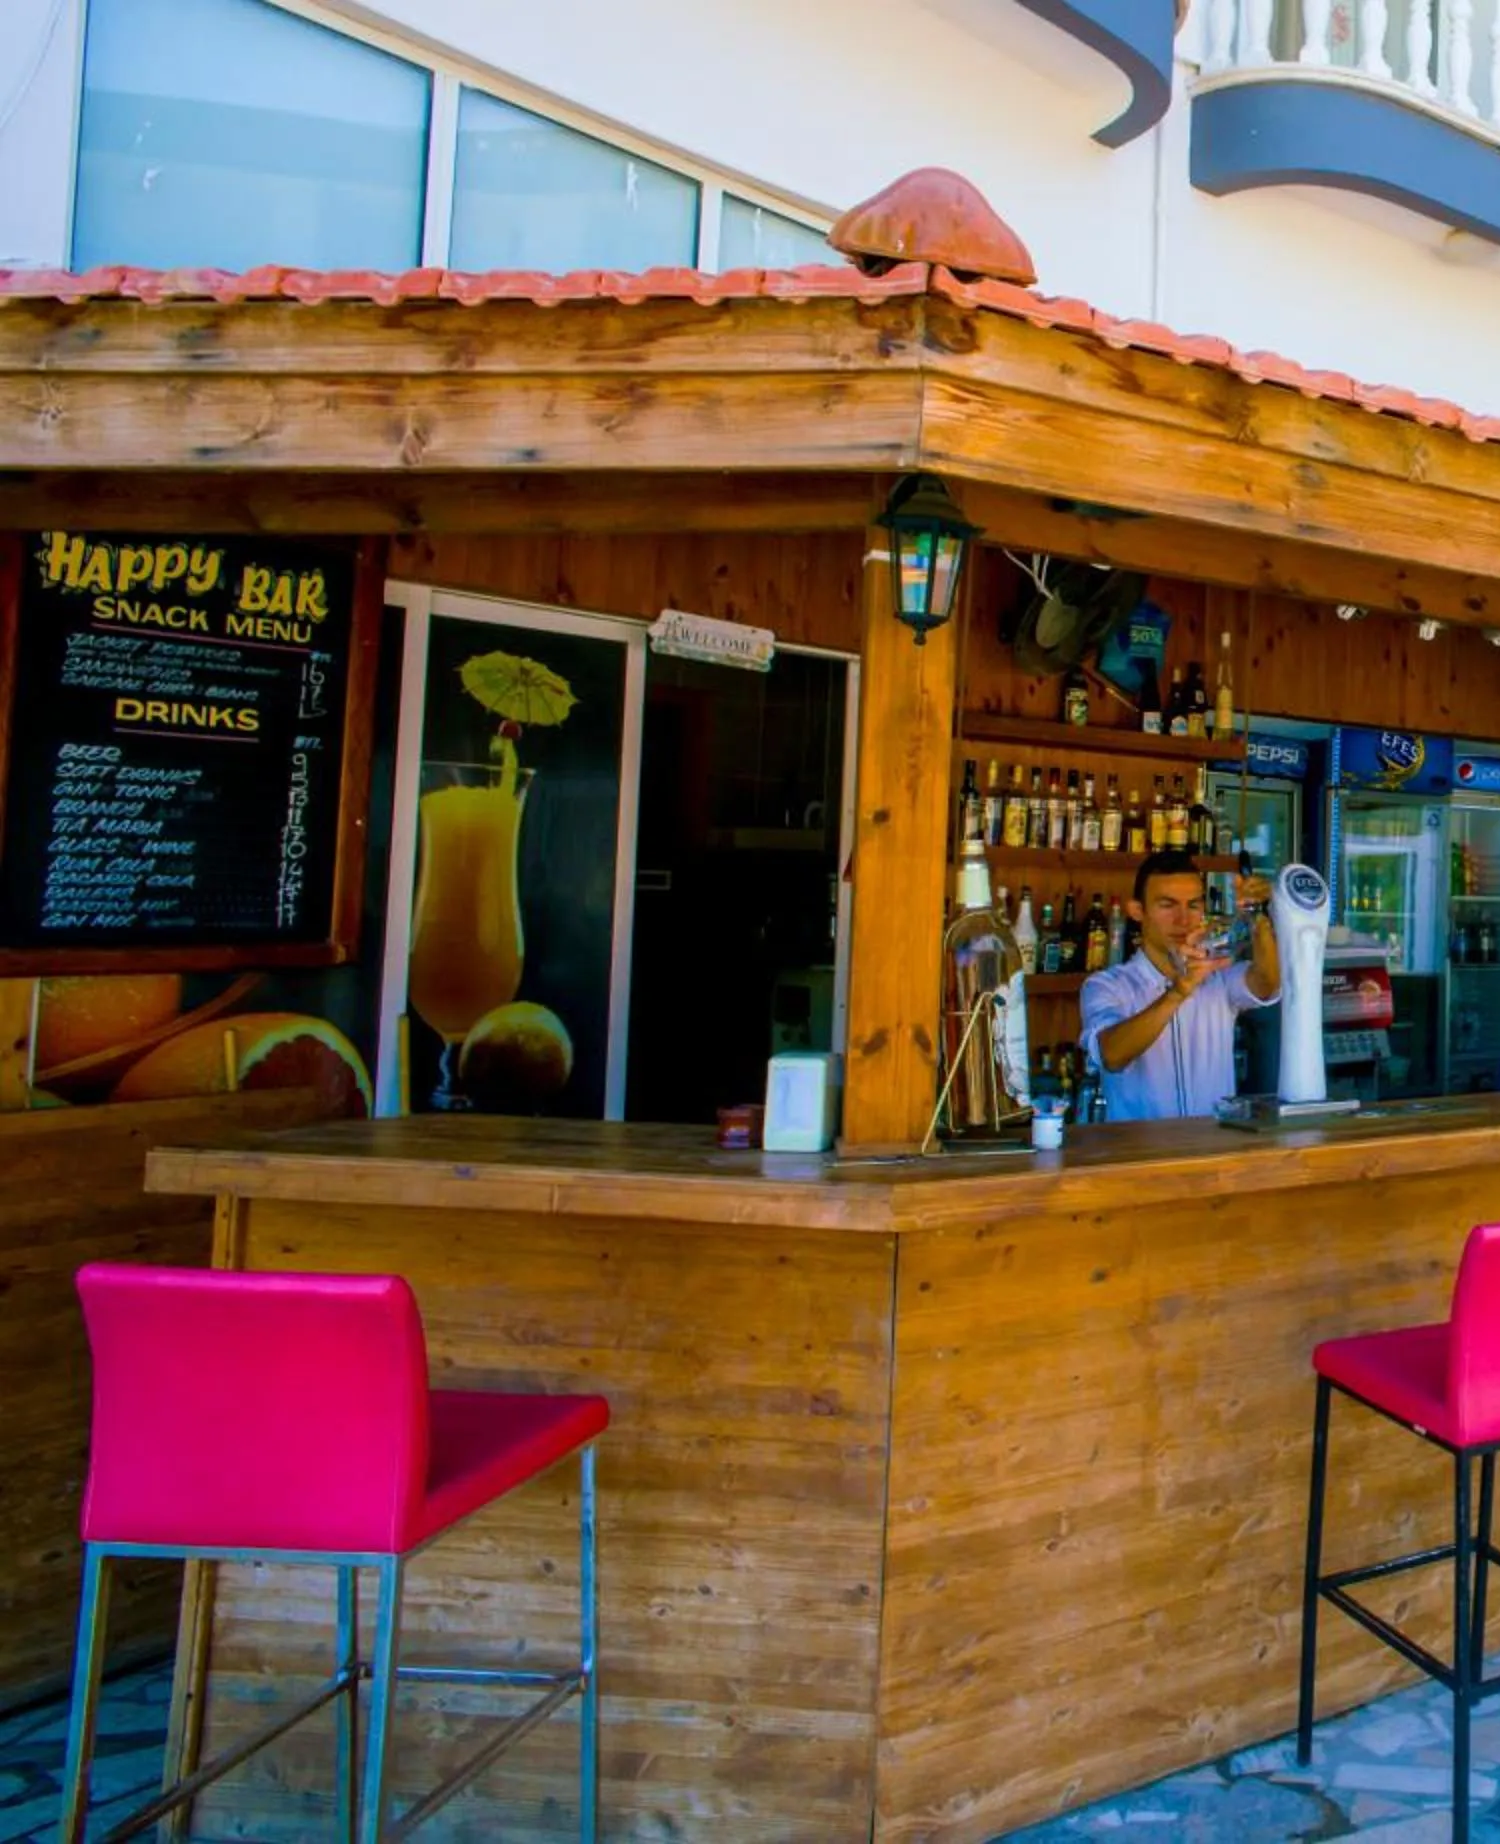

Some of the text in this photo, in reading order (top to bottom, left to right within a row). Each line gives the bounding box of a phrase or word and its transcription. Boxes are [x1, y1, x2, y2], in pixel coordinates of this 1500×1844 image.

[48, 531, 328, 619] HAPPY BAR
[92, 596, 312, 643] SNACK MENU
[680, 626, 752, 653] WELCOME
[115, 698, 260, 731] DRINKS
[58, 743, 122, 762] BEER
[1247, 743, 1299, 765] PEPSI
[55, 762, 117, 779] SOFT
[52, 781, 101, 796] GIN
[115, 784, 178, 801] TONIC
[52, 799, 147, 817] BRANDY
